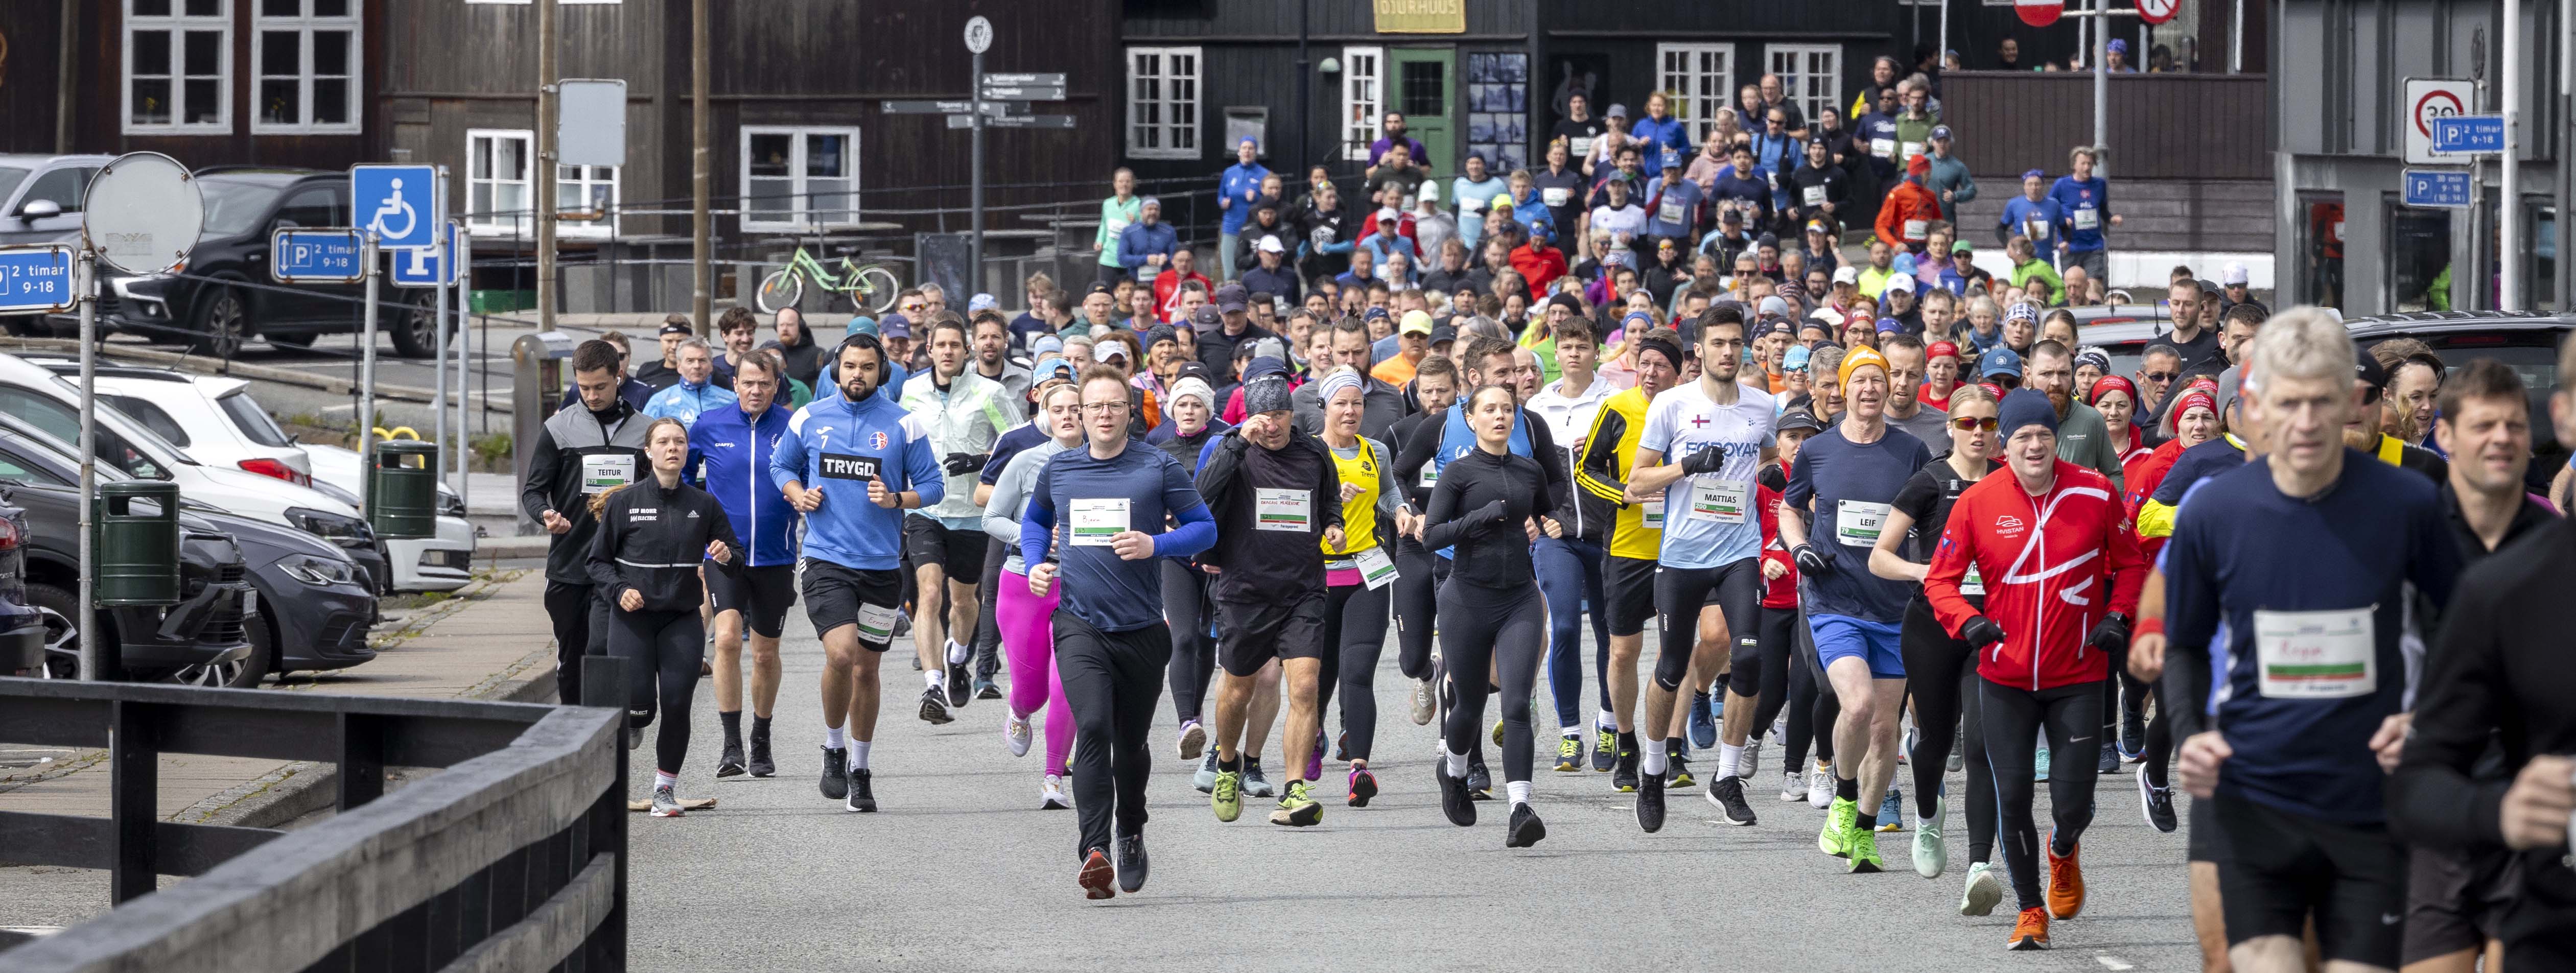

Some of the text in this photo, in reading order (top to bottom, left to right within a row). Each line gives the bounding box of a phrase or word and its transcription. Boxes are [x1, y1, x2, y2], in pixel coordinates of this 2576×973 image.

[2464, 125, 2470, 134] 2
[2471, 136, 2494, 144] 9-18
[315, 244, 322, 254] 2
[295, 246, 308, 264] P
[323, 257, 348, 267] 9-18
[12, 265, 65, 277] 2 tímar
[22, 281, 54, 294] 9-18
[821, 435, 829, 449] 7
[824, 458, 875, 477] TRYGD
[1704, 493, 1737, 504] MATTIAS
[1860, 518, 1877, 527] LEIF
